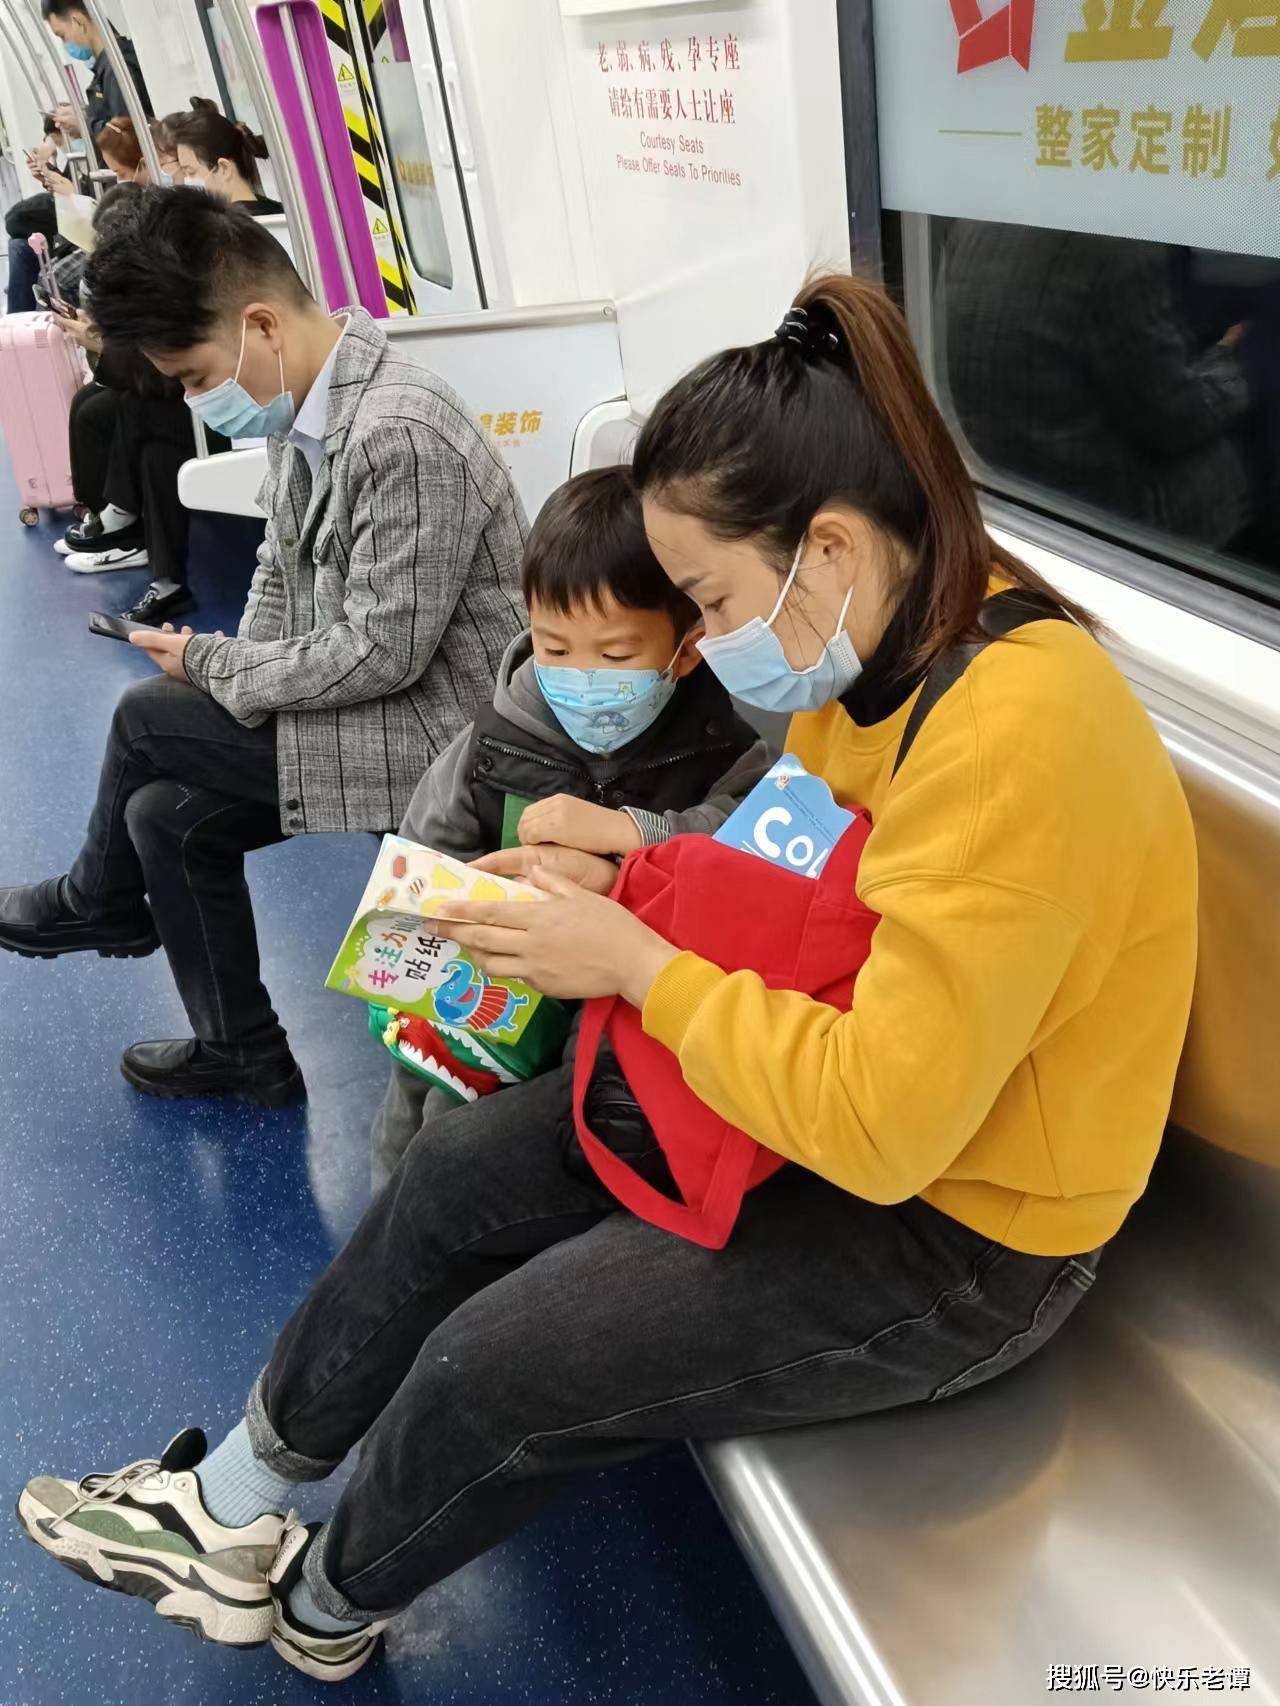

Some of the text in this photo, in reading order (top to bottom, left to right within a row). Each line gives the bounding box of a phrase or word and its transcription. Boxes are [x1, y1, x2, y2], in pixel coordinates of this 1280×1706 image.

[608, 87, 736, 124] 请给有需要人士让座
[640, 131, 704, 155] Courtesy Seats
[1035, 102, 1231, 180] 整家定制
[616, 154, 741, 186] Please Offer Seats To Priorities
[404, 936, 447, 980] 贴纸
